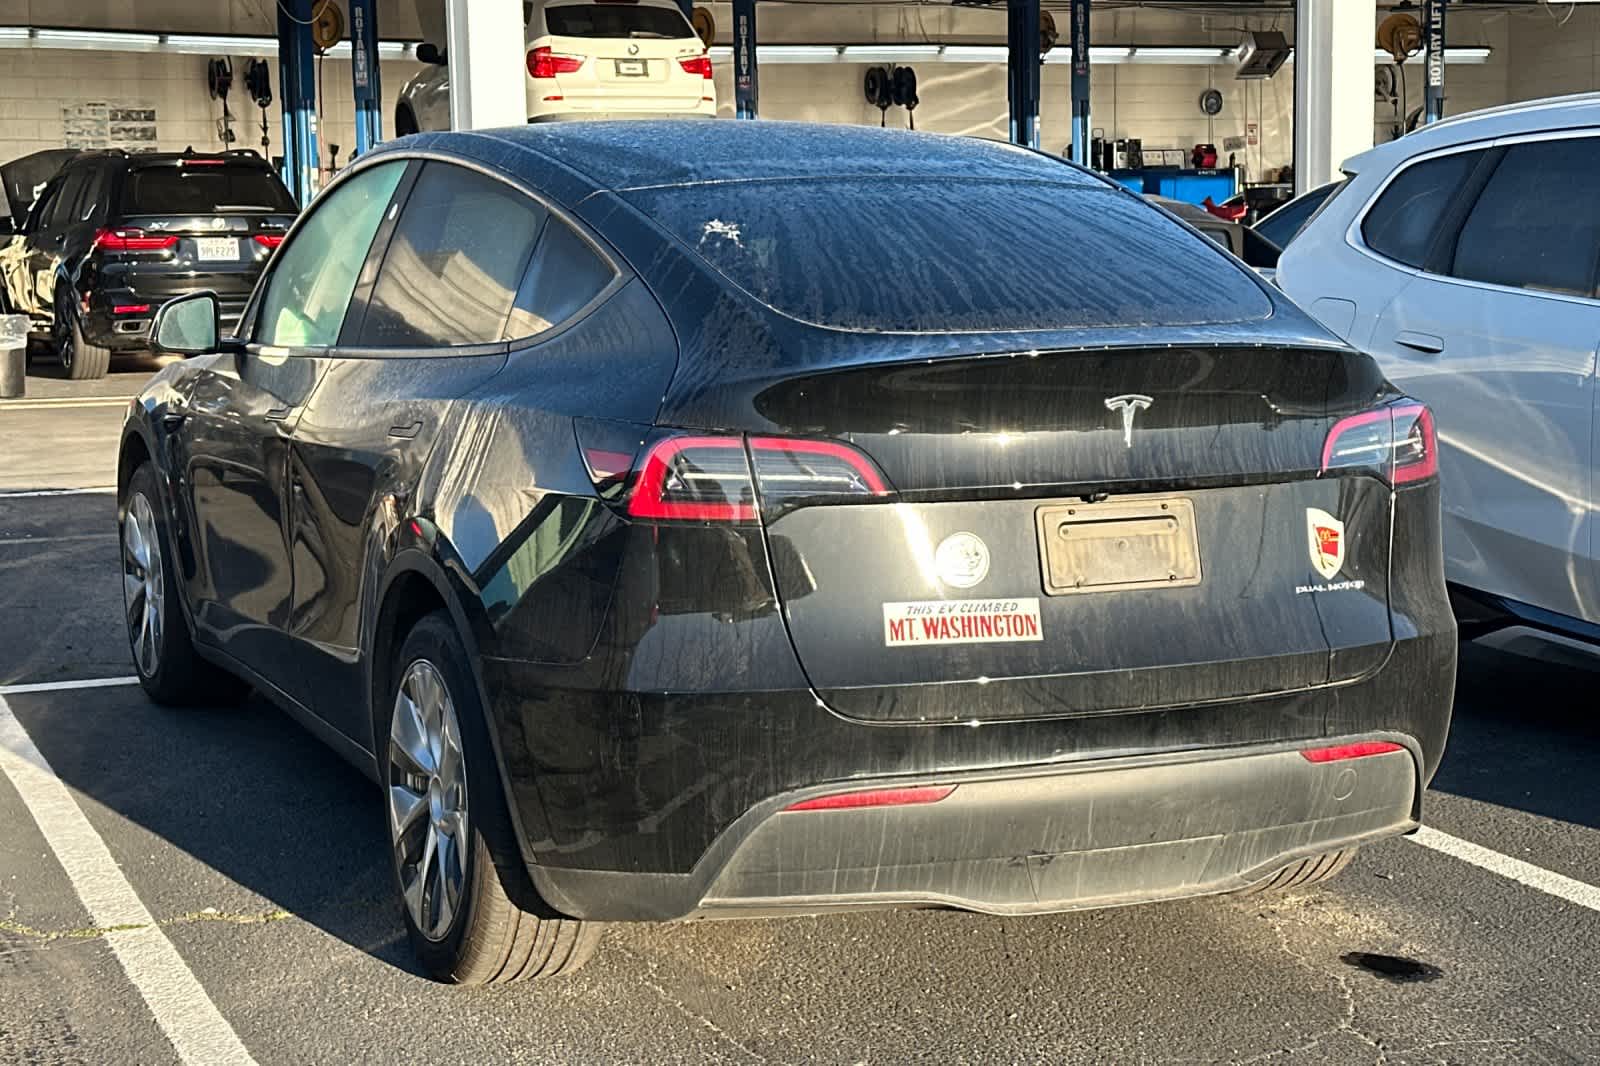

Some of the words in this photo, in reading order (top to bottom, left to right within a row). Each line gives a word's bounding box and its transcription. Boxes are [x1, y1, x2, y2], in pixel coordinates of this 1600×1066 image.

[1077, 3, 1085, 61] ROTARY
[1431, 1, 1442, 28] LIFT
[355, 7, 365, 71] ROTARY
[740, 15, 748, 75] ROTARY
[1431, 33, 1442, 86] ROTARY
[1295, 584, 1327, 594] DUAL
[1327, 580, 1365, 591] MOTOR
[889, 618, 919, 642] MT.
[922, 614, 1038, 640] WASHINGTON
[906, 605, 933, 616] THIS
[938, 604, 957, 614] EV
[960, 602, 1019, 613] CLIMBED
